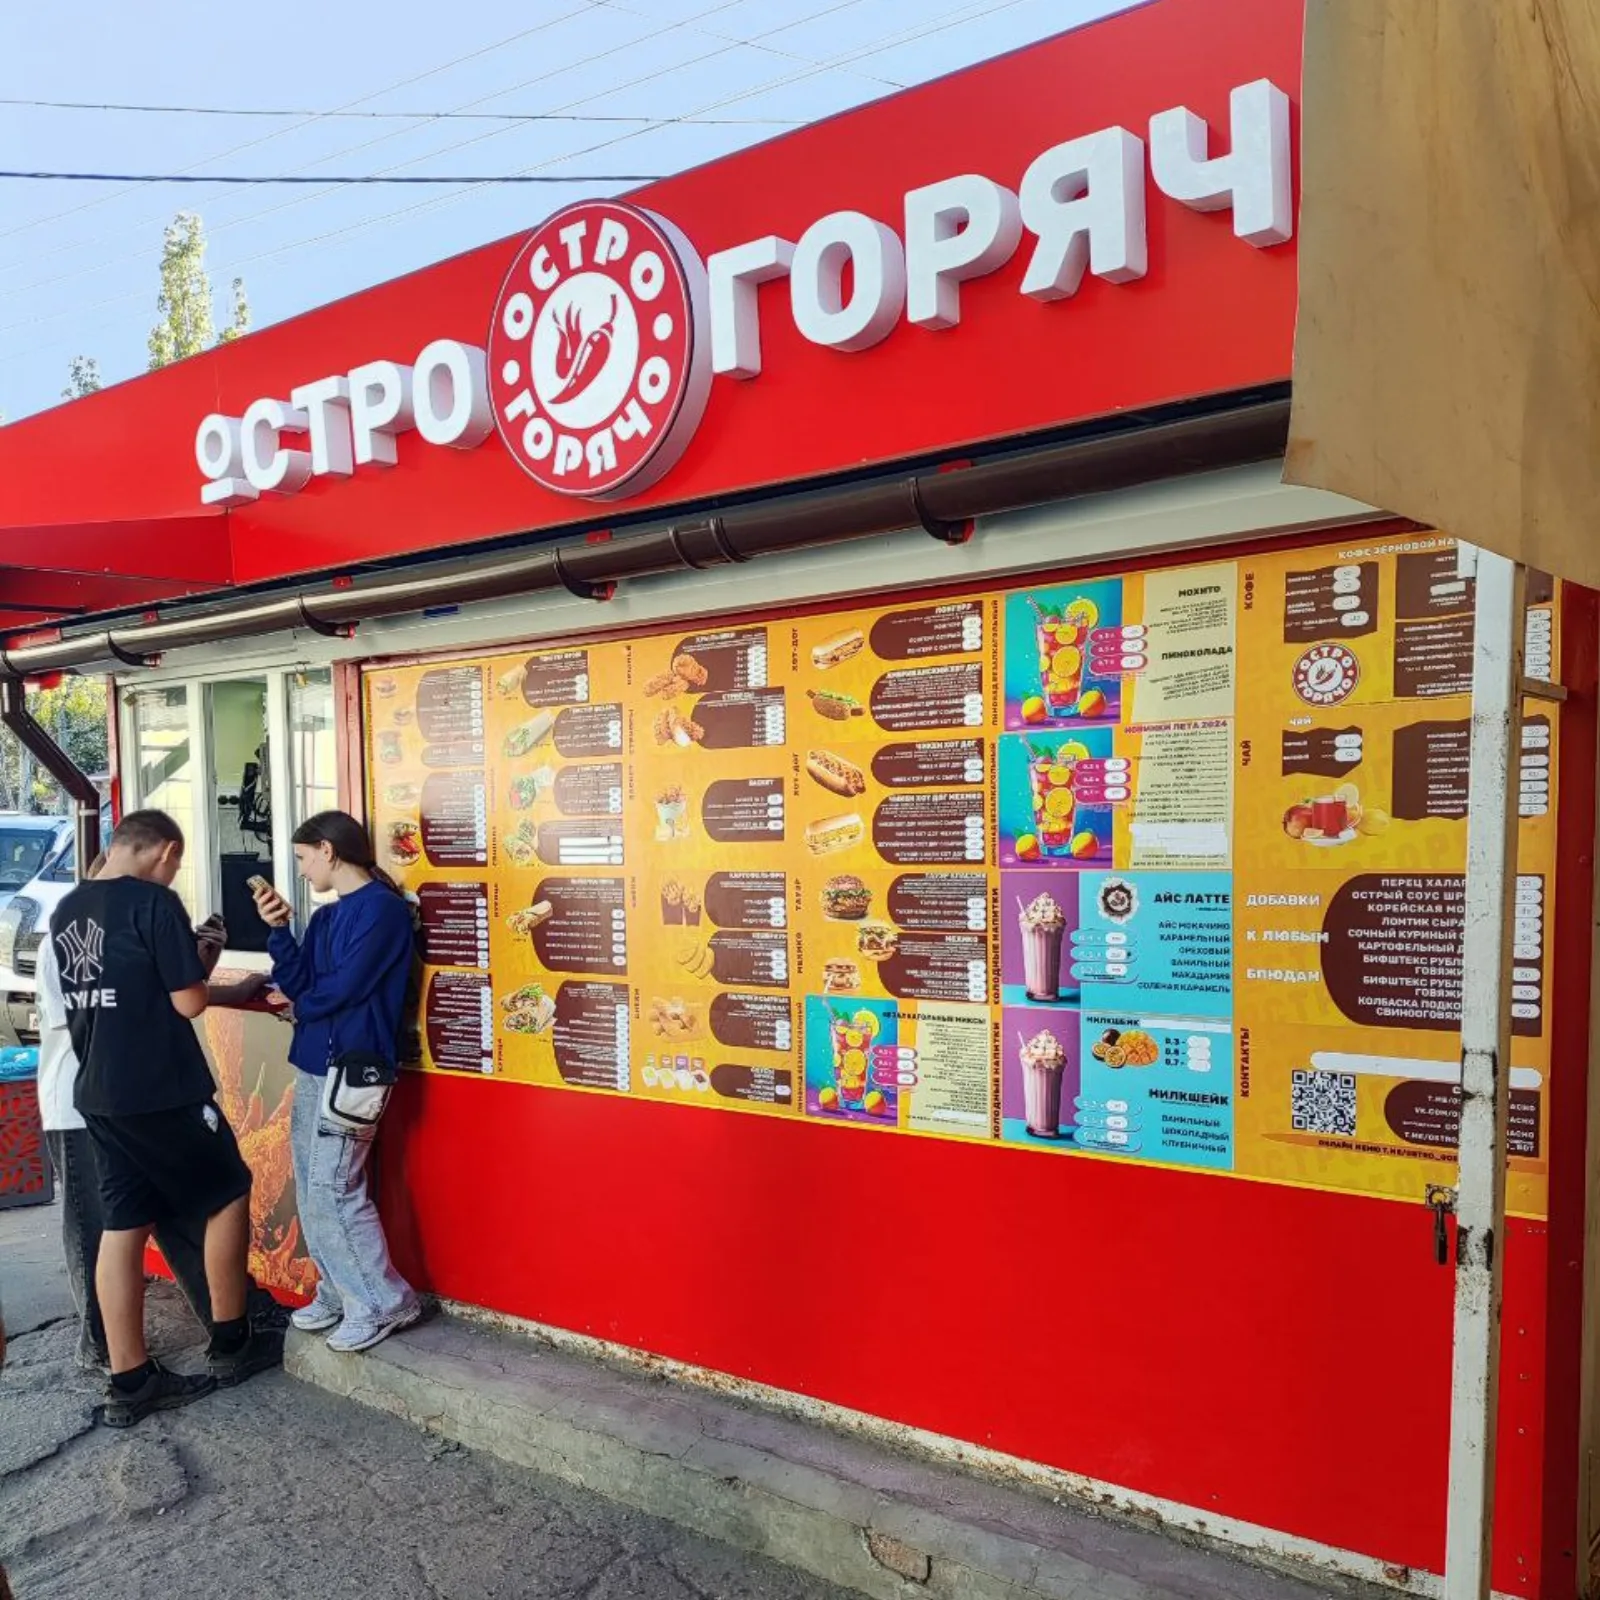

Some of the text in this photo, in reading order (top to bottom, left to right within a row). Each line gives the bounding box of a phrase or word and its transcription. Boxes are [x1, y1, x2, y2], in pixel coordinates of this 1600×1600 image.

[503, 217, 665, 341] ОСТРО
[195, 338, 488, 506] ОСТРО
[503, 355, 671, 478] ГОРЯЧО
[1178, 585, 1221, 598] МОХИТО
[1244, 573, 1255, 611] КОФЕ
[1299, 646, 1353, 671] ОСТРО
[1297, 677, 1353, 704] ГОРЯЧО
[1240, 739, 1251, 767] ЧАЙ
[1381, 878, 1423, 888] ПЕРЕЦ
[1153, 891, 1231, 905] АЙС ЛАТТЕ
[1246, 894, 1320, 907] ДОБАВКИ
[1351, 890, 1403, 900] ОСТРЫЙ
[1406, 891, 1440, 900] СОУС
[1367, 903, 1443, 913] КОРЕЙСКАЯ
[1246, 930, 1330, 943] К ЛЮБЫМ
[1347, 927, 1457, 940] СОЧНЫЙ КУРИНЫЙ
[1358, 941, 1454, 953] КАРТОФЕЛЬНЫЙ
[1363, 954, 1428, 965] БИФШТЕКС
[1363, 975, 1428, 987] БИФШТЕКС
[1358, 996, 1419, 1008] КОЛБАСКА
[1240, 1026, 1250, 1098] КОНТАКТЫ
